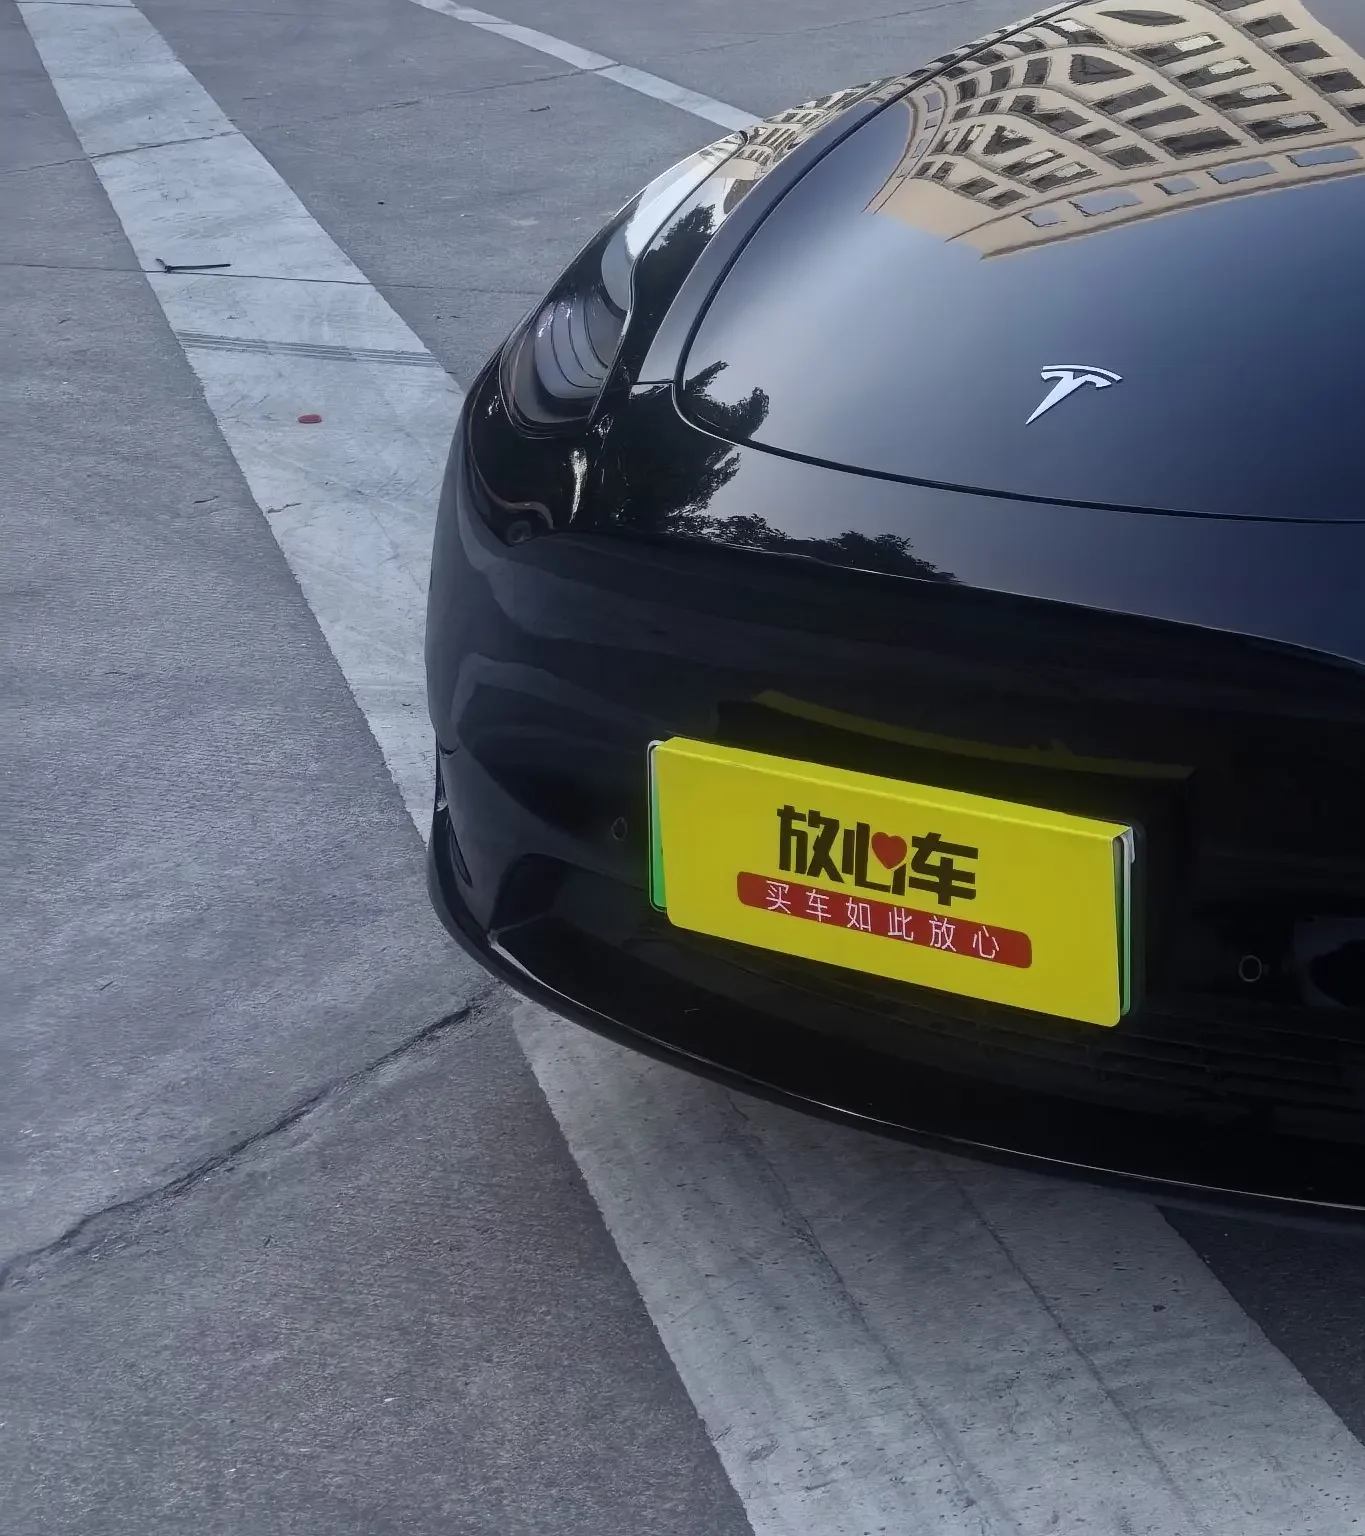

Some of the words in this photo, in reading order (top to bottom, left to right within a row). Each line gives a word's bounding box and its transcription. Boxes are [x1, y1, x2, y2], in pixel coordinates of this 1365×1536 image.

[777, 804, 979, 906] 放心车
[766, 880, 999, 959] 买车如此放心
